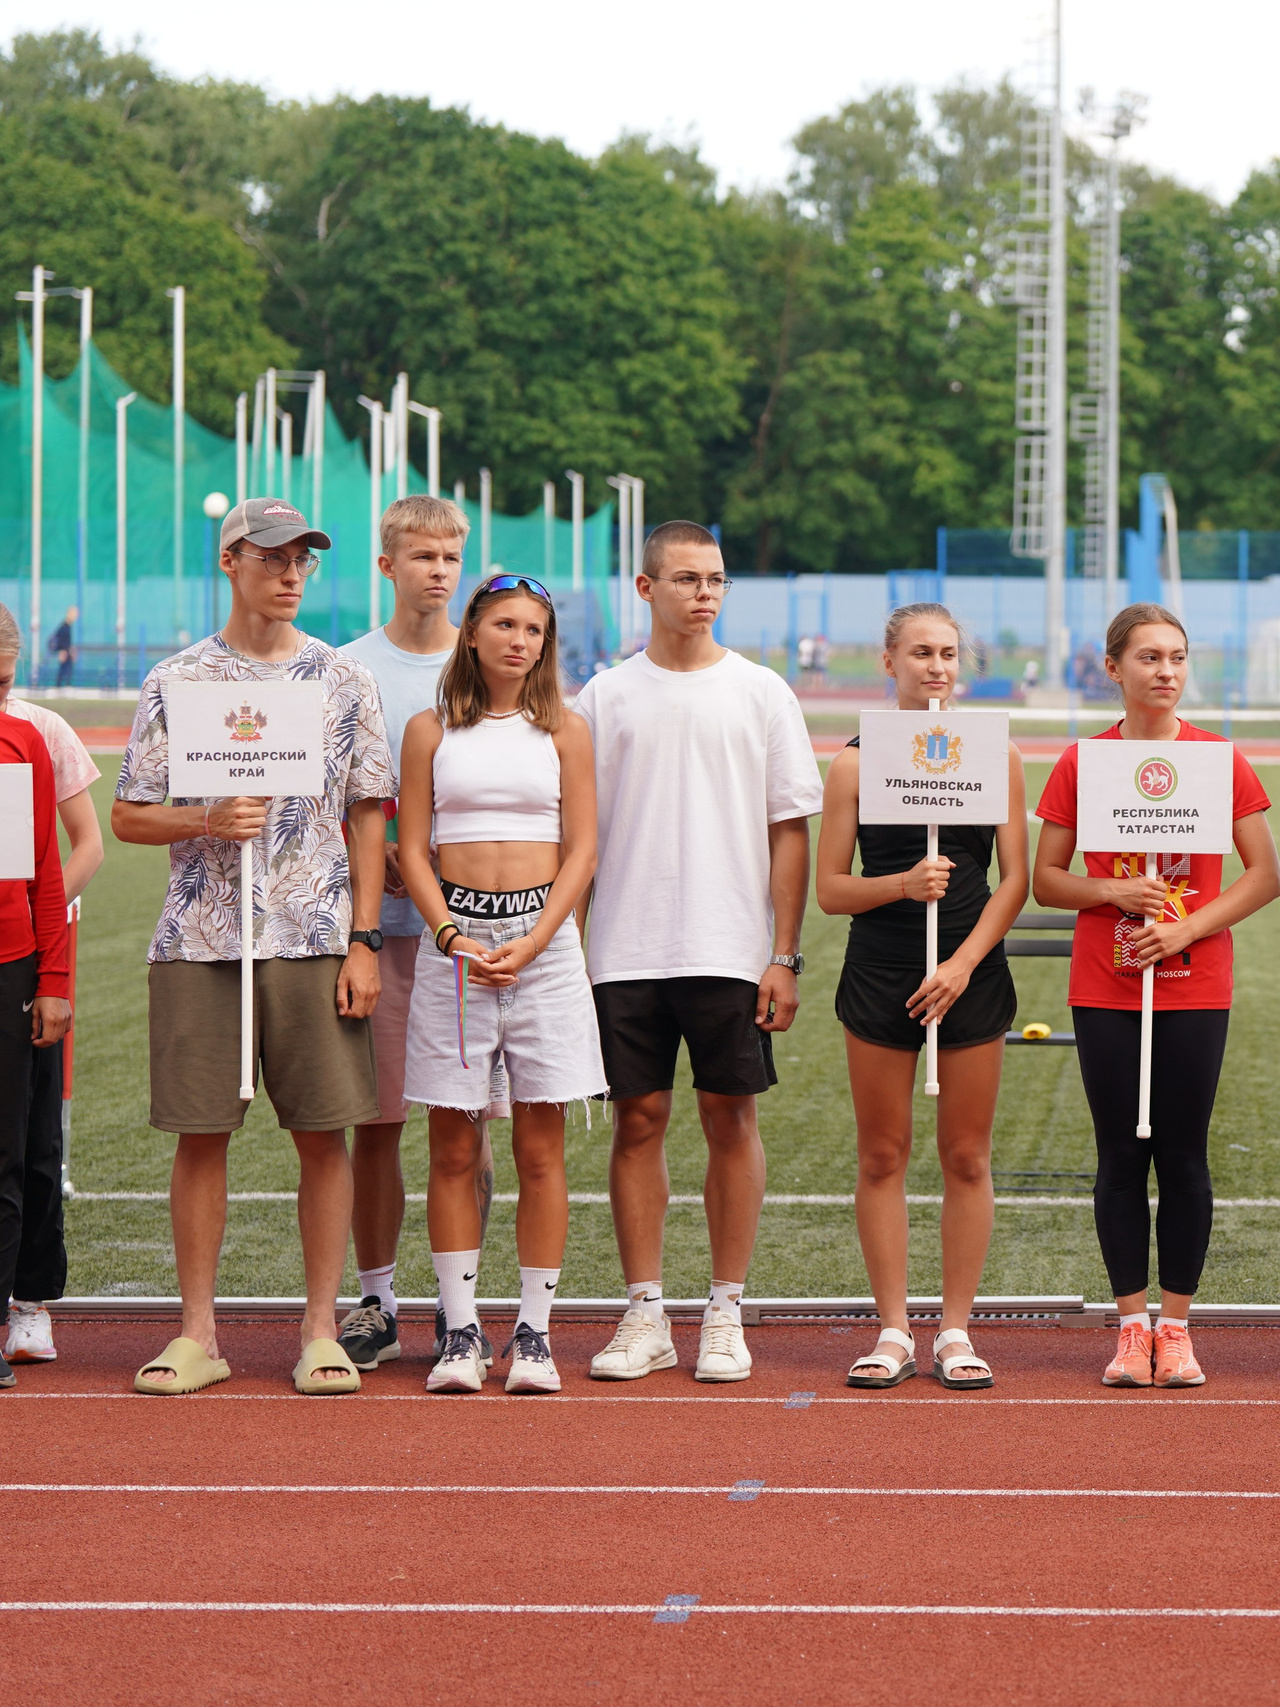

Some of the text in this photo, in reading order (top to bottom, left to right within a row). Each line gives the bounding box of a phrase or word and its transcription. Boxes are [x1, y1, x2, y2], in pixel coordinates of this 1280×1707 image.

[186, 749, 307, 762] КРАСНОДАРСКИЙ
[229, 766, 265, 777] КРАЙ
[885, 778, 982, 792] УЛЬЯНОВСКАЯ
[902, 795, 964, 807] ОБЛАСТЬ
[1113, 808, 1199, 818] РЕСПУБЛИКА
[1117, 825, 1195, 834] ТАТАРСТАН
[448, 886, 550, 914] EAZYWAY
[1157, 970, 1191, 978] MOSCOW
